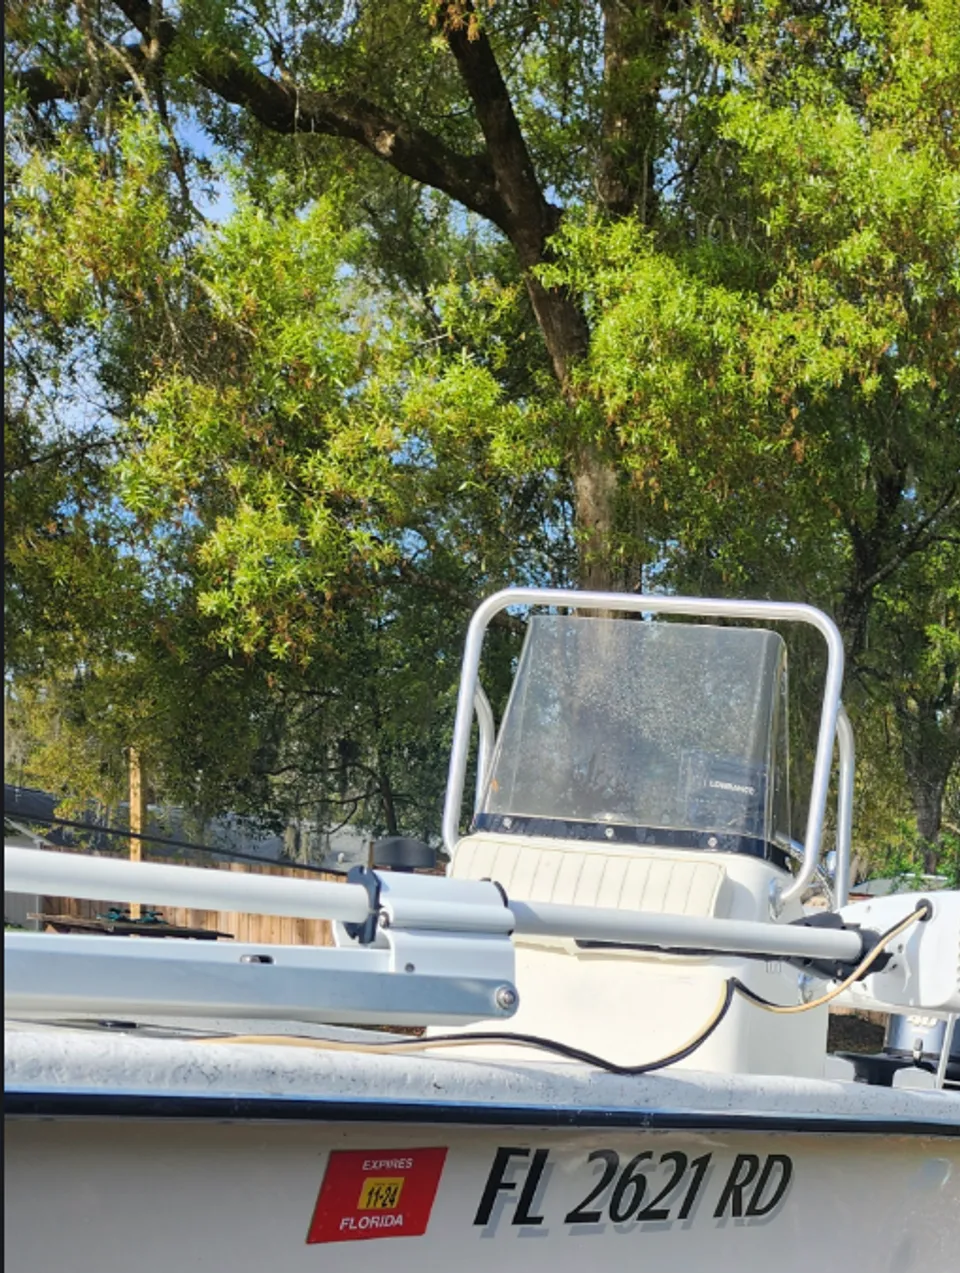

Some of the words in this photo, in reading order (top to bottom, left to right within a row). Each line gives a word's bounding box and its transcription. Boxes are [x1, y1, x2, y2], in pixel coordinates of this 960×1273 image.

[362, 1158, 414, 1171] EXPIRES
[365, 1185, 400, 1209] 11-24
[473, 1147, 551, 1228] FL
[564, 1150, 713, 1226] 2621
[713, 1153, 795, 1221] RD
[339, 1214, 404, 1231] FLORIDA
